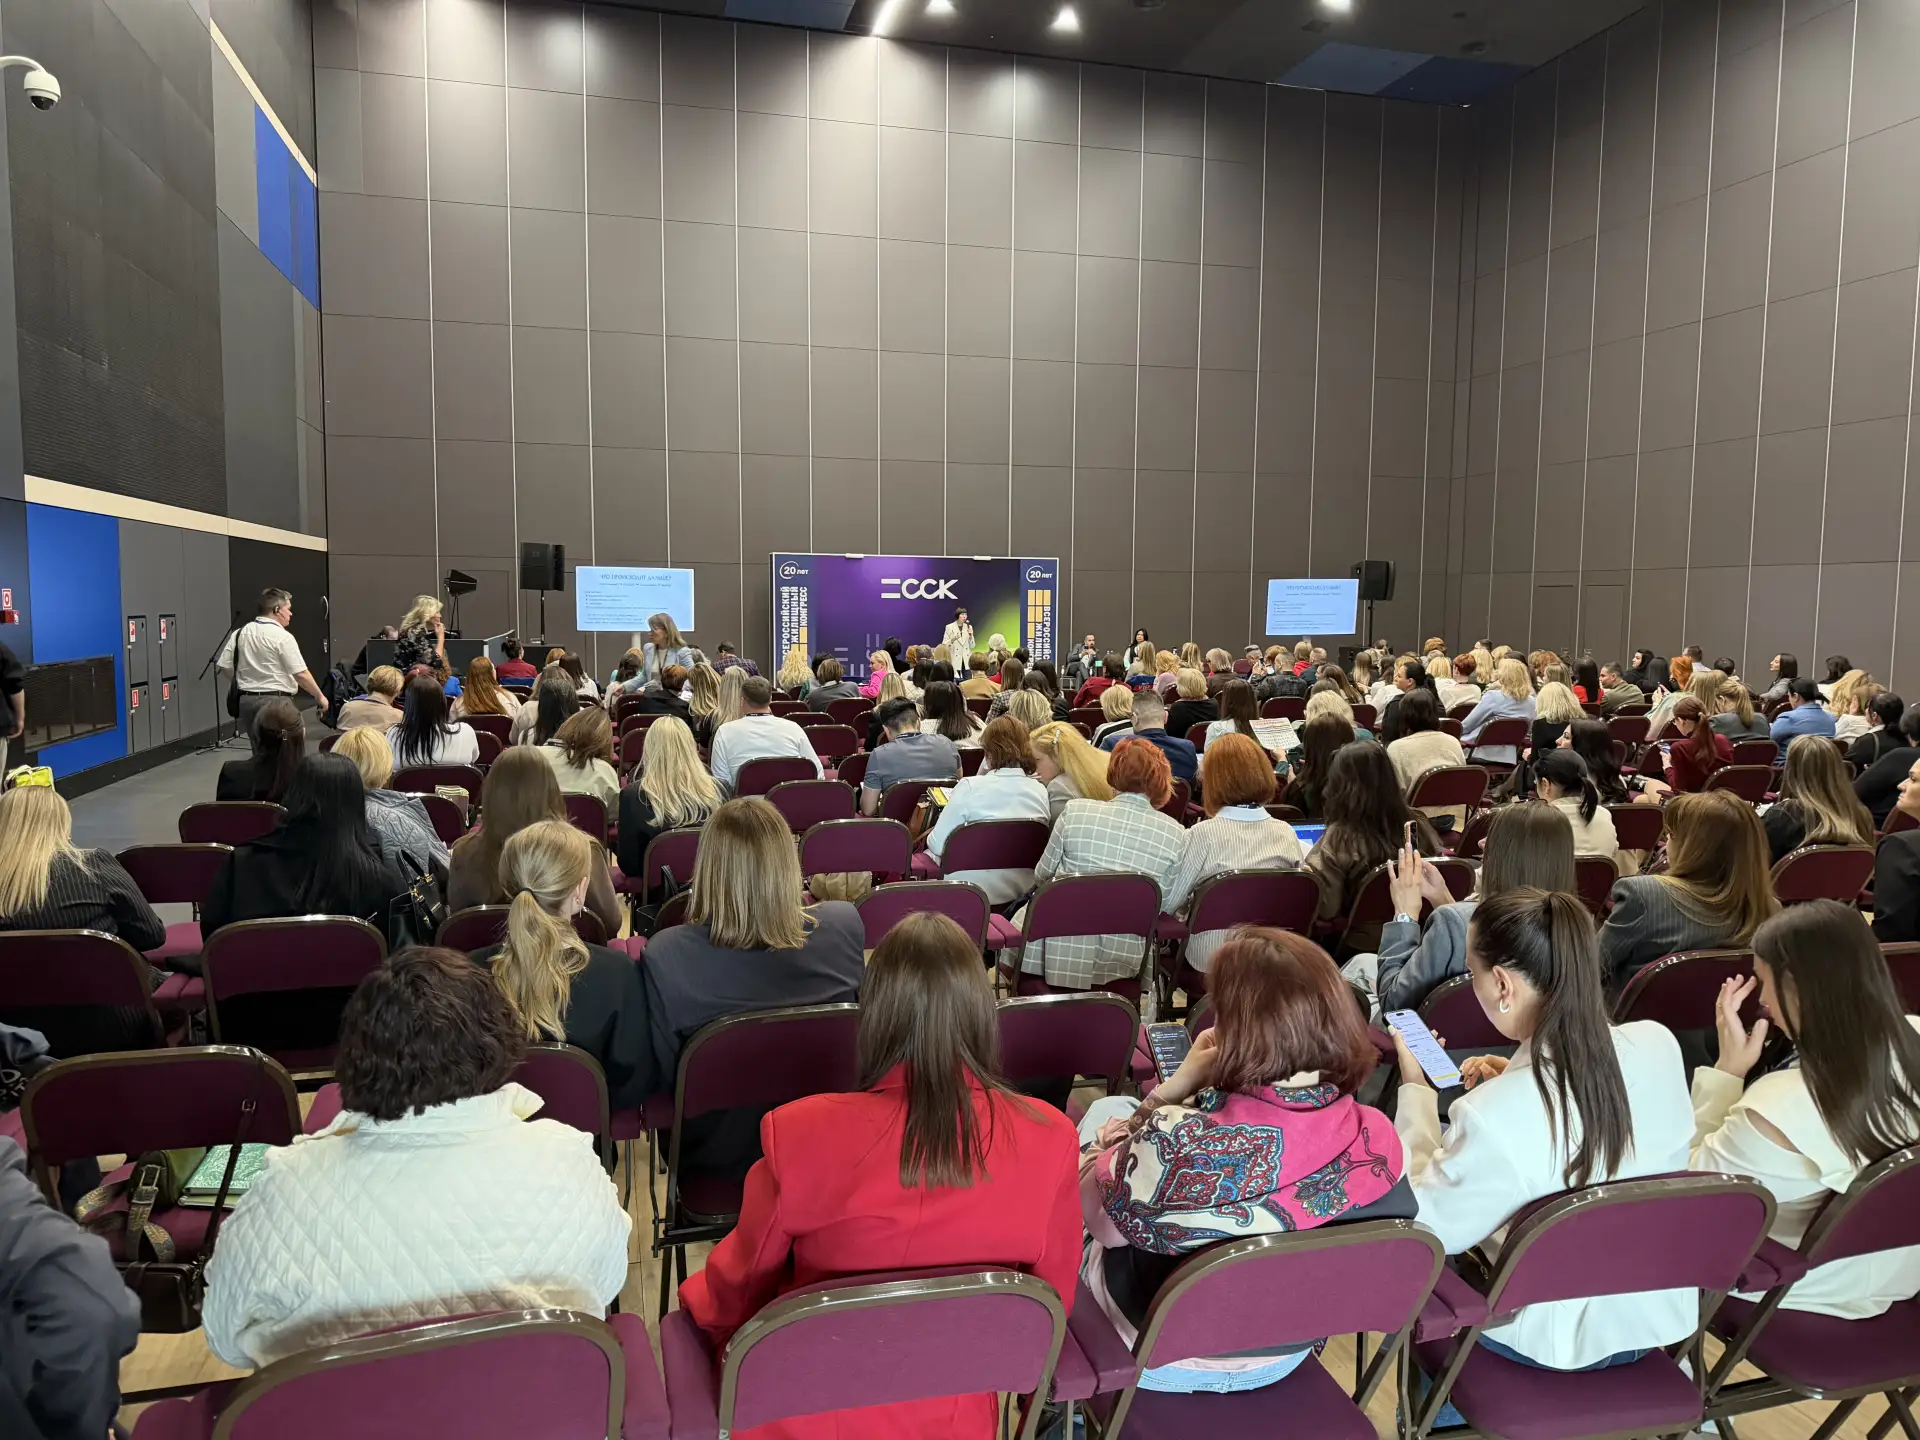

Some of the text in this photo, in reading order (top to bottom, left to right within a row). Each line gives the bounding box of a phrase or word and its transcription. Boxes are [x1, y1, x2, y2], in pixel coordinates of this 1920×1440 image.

[783, 566, 796, 575] 20
[1029, 570, 1041, 579] 20
[790, 586, 799, 644] ЖИЛИЩНЫЙ
[799, 586, 808, 627] КОНГРЕСС
[1043, 606, 1051, 660] ВСЕРОССИЙС
